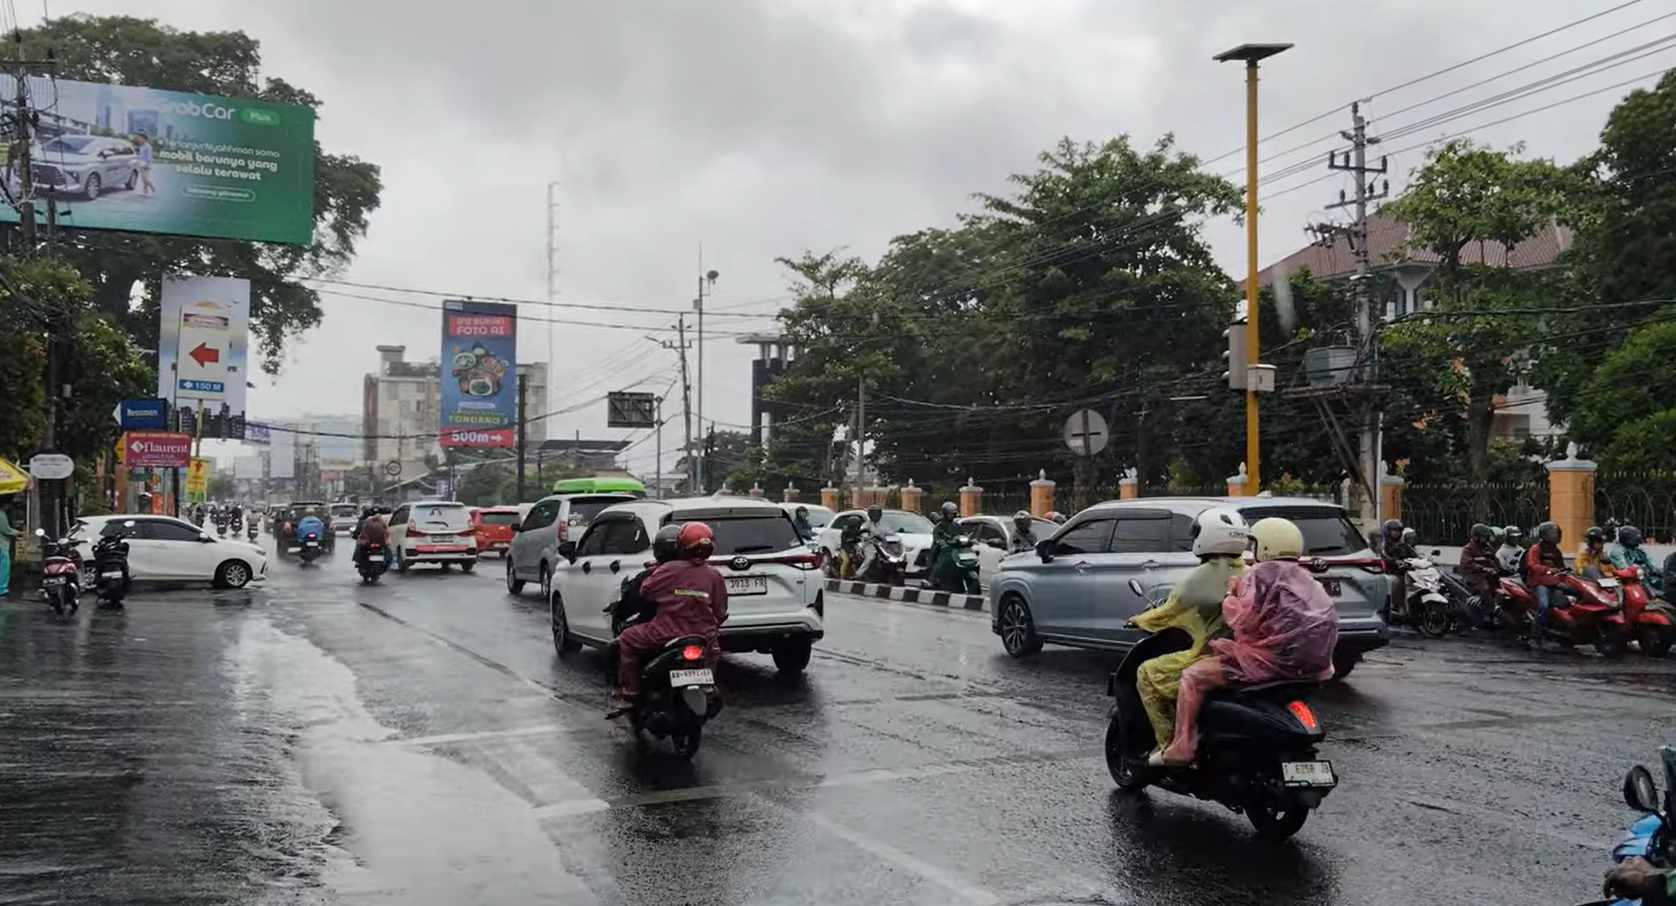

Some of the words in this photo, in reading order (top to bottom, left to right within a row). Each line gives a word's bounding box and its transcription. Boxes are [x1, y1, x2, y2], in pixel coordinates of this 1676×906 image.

[160, 150, 194, 161] mobil
[195, 154, 245, 168] barunya
[247, 160, 278, 172] yang
[176, 163, 213, 177] selalu
[214, 167, 261, 180] terawat
[457, 326, 487, 335] FOTO
[452, 430, 489, 443] 500m
